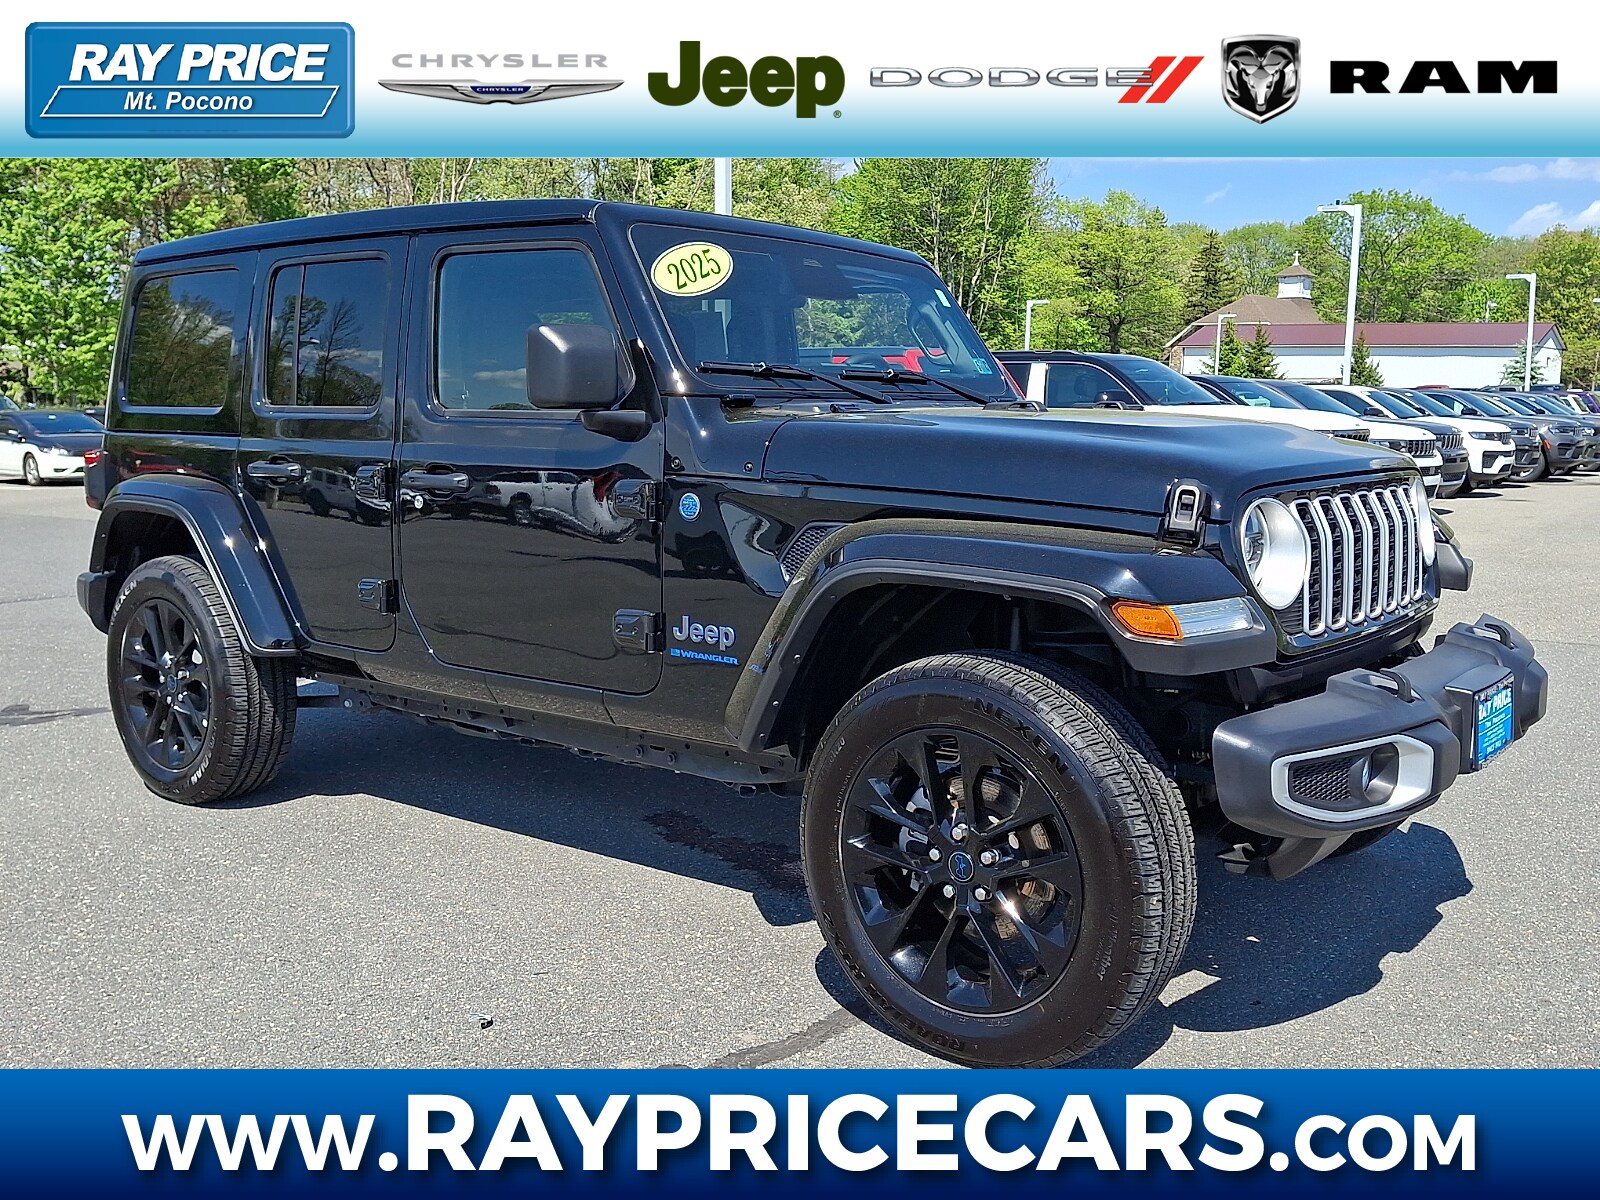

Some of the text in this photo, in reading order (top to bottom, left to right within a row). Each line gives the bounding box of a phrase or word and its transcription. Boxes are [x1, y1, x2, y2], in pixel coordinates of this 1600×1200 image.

[667, 249, 722, 290] 2025
[673, 615, 735, 652] Jeep
[680, 649, 740, 666] WRANGLER
[1493, 687, 1512, 713] PRICE
[973, 697, 1070, 777] NEXEN
